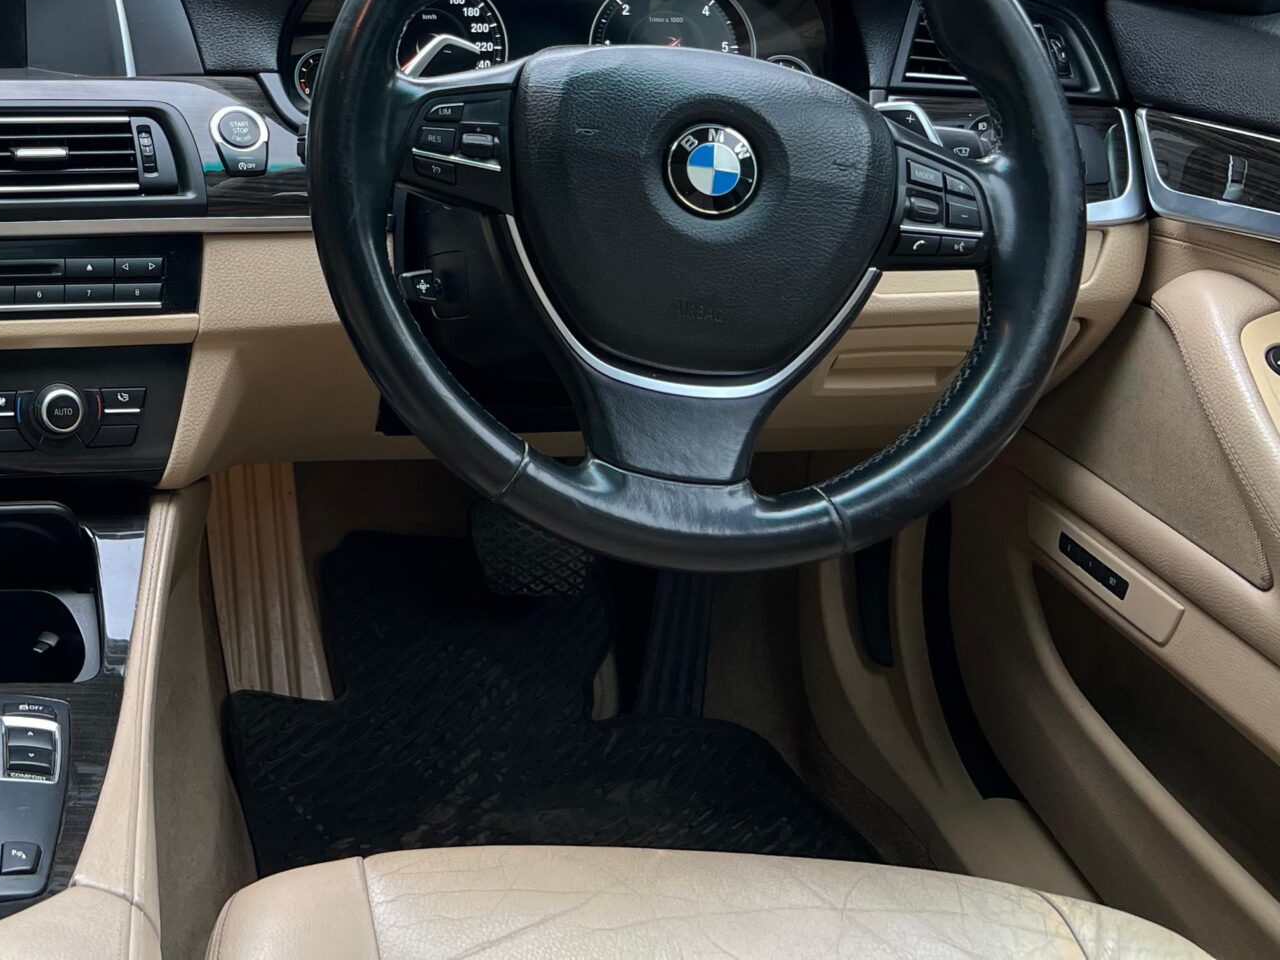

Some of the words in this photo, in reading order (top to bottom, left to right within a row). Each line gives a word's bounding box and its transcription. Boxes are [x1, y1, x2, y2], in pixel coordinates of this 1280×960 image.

[462, 7, 480, 17] 180
[621, 4, 630, 16] 2
[701, 5, 710, 17] 4
[471, 23, 489, 33] 200
[721, 41, 729, 53] 5
[438, 108, 452, 116] LIM
[232, 127, 249, 135] STOP
[427, 134, 442, 143] RES
[680, 128, 751, 160] BMW
[915, 170, 934, 181] MODE
[36, 290, 43, 299] 6
[86, 289, 92, 298] 7
[134, 288, 140, 297] 8
[53, 407, 73, 417] AUTO
